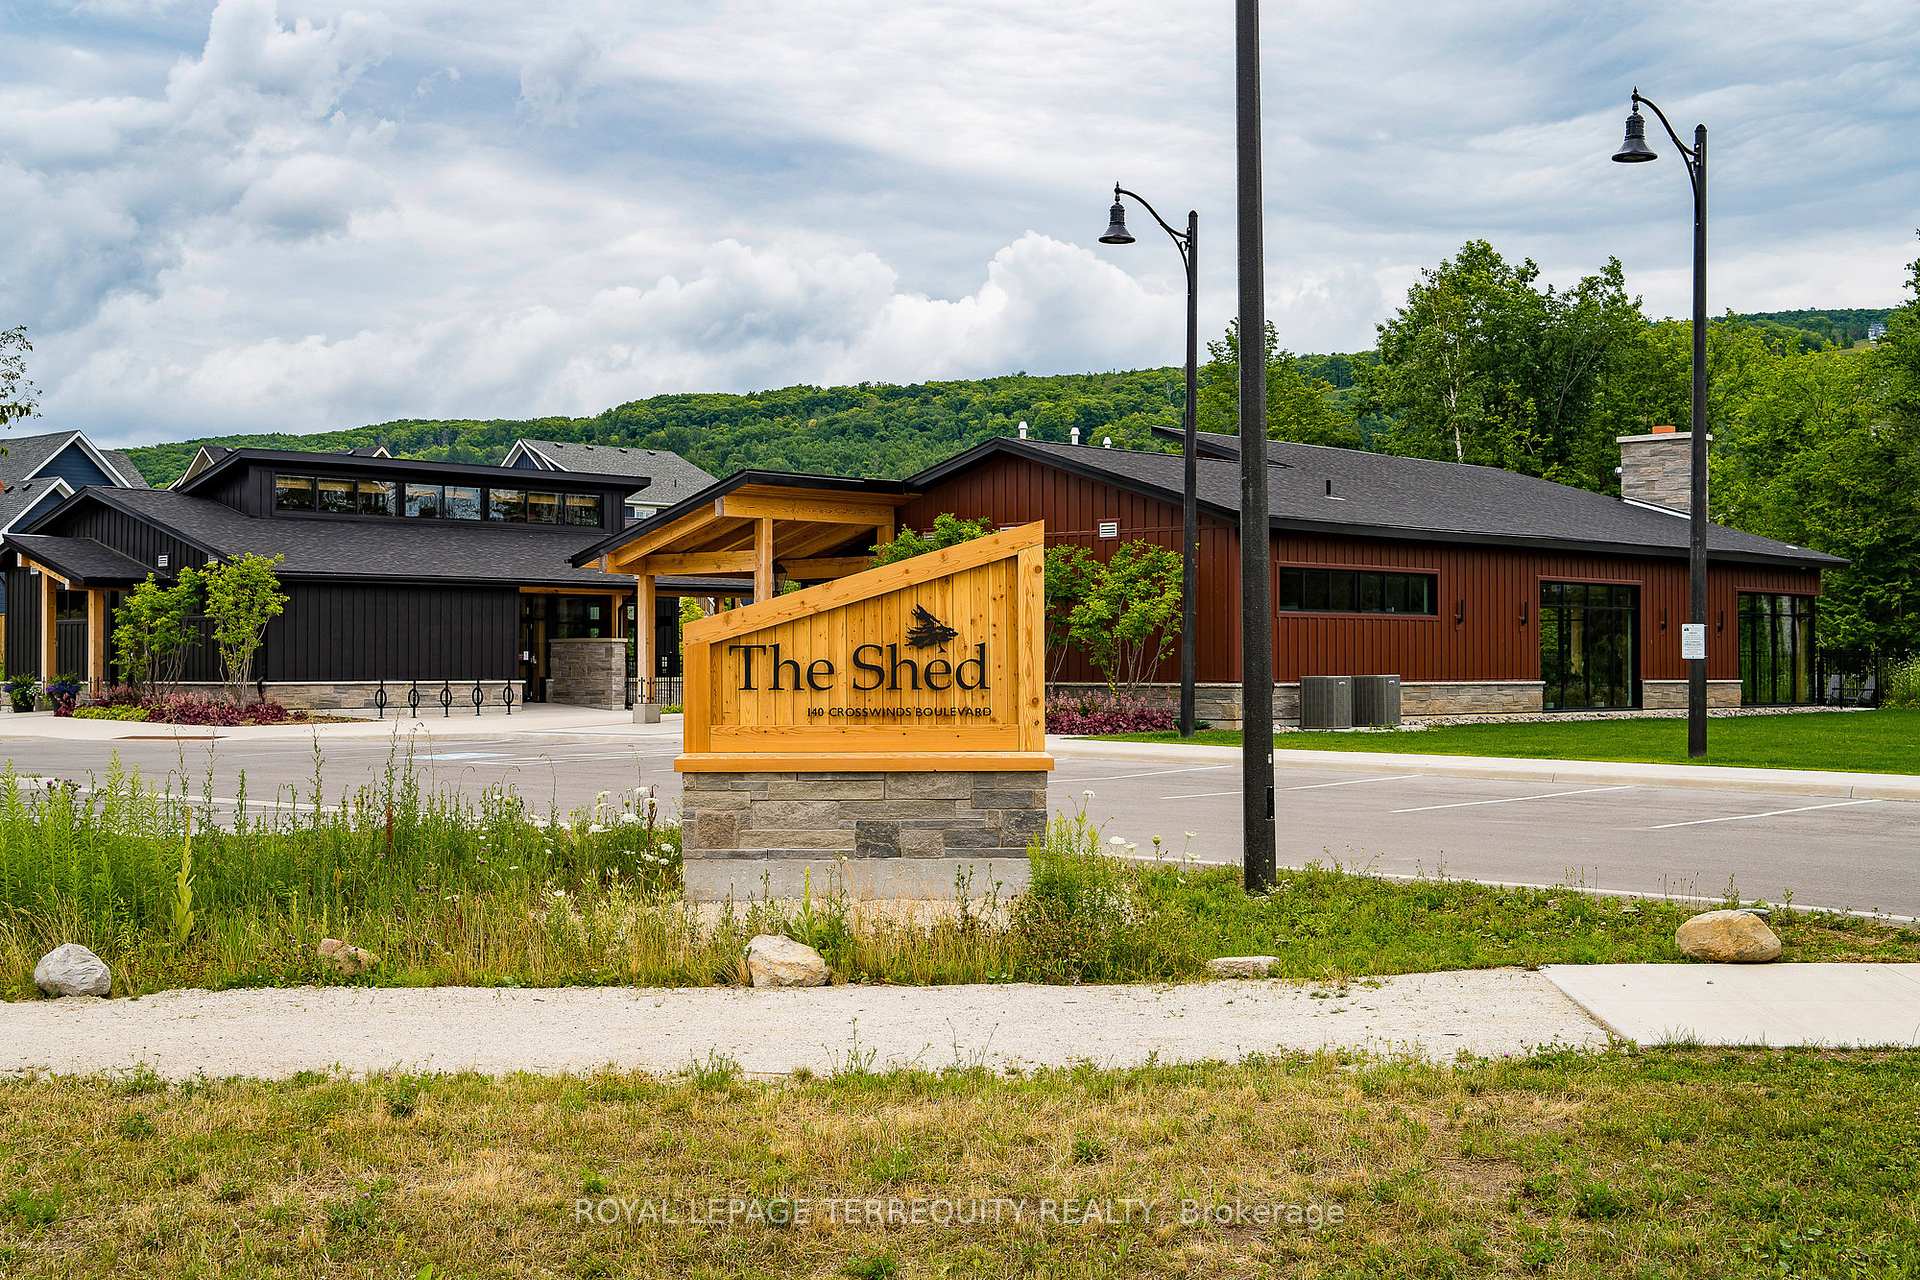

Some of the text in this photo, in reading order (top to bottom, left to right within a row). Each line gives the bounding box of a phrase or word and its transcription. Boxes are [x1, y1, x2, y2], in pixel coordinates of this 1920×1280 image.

[729, 642, 991, 691] The Shed
[807, 707, 992, 717] 140 CROSSWINDS BOULEVARD
